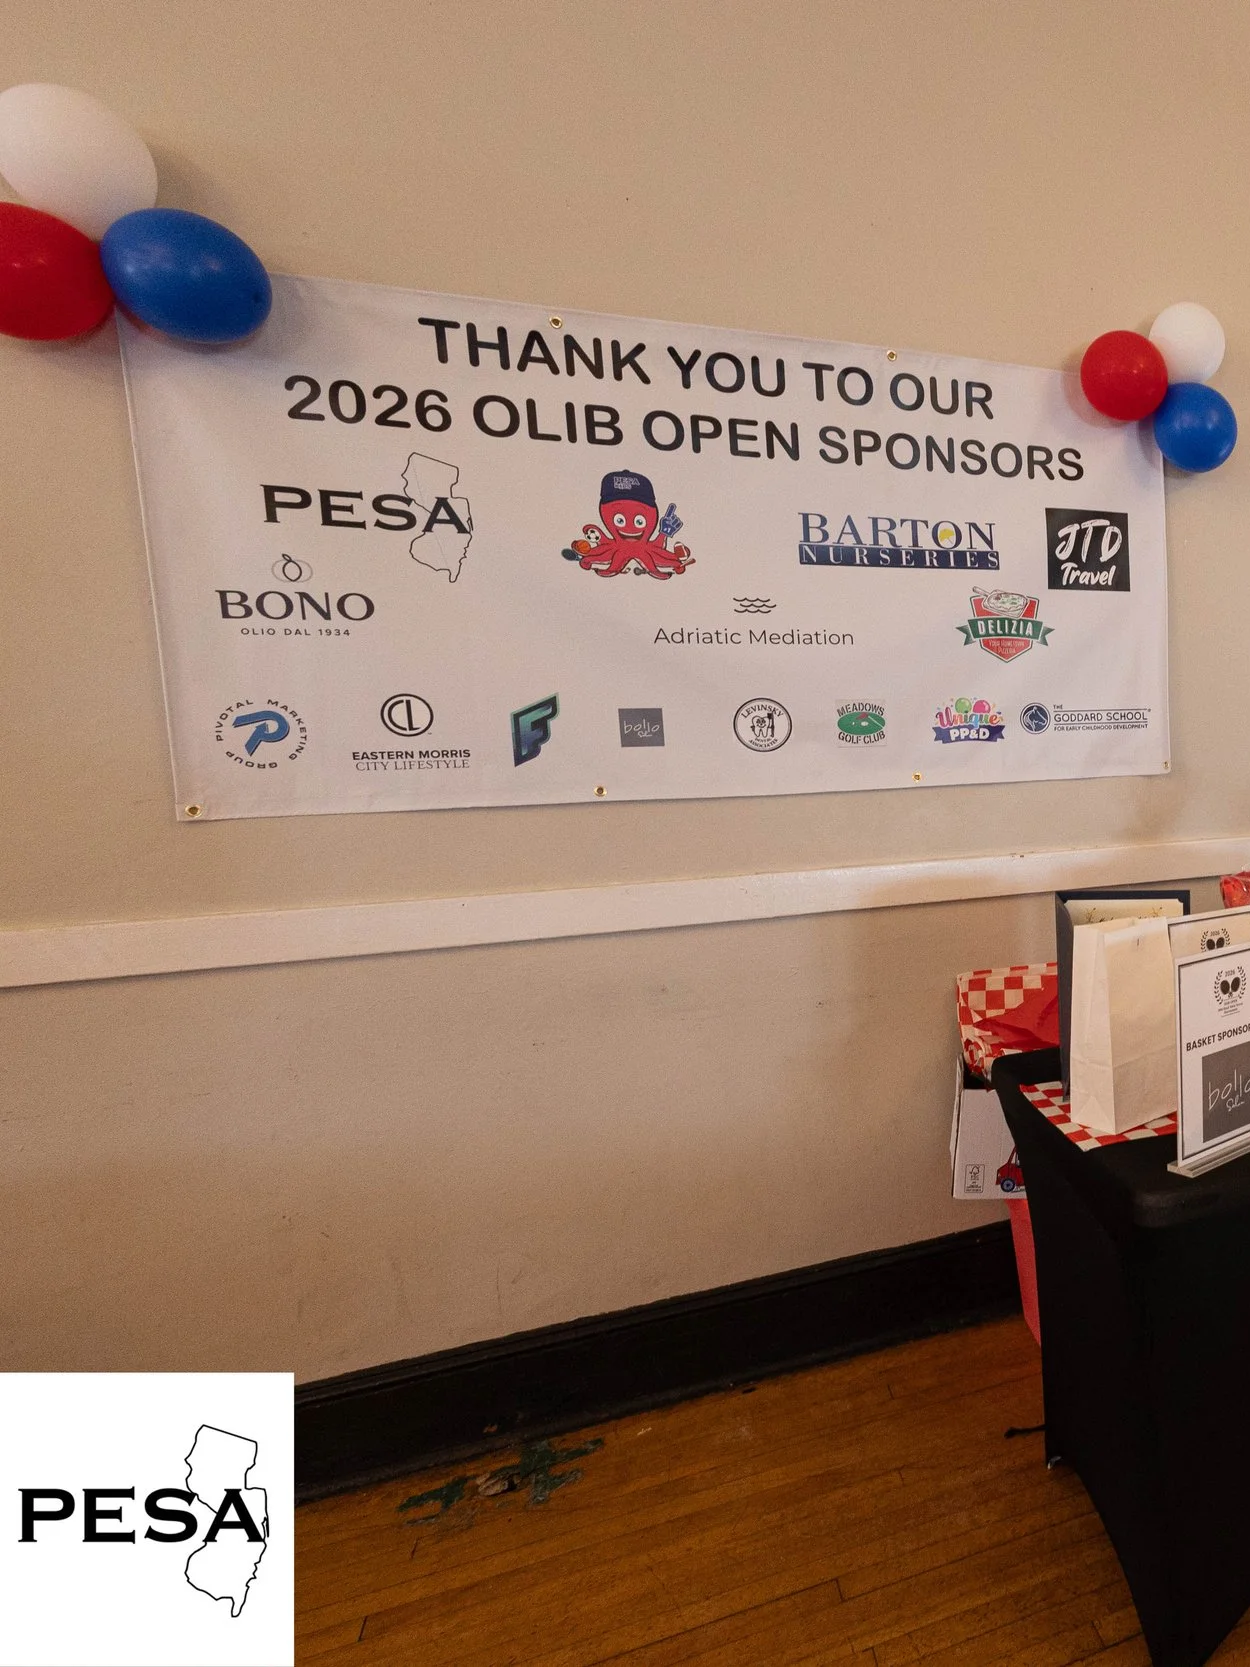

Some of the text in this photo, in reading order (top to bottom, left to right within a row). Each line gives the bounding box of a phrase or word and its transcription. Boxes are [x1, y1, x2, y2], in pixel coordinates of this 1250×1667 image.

[418, 317, 994, 420] THANK YOU TO OUR
[284, 375, 1084, 482] 2026 OLIB OPEN SPONSORS
[260, 484, 469, 534] PESA
[798, 512, 995, 550] BARTON
[1055, 518, 1123, 562] JTD
[802, 546, 999, 568] NURSERIES
[1060, 562, 1117, 586] Travel
[215, 590, 375, 621] BONO
[241, 628, 351, 637] OLIO DAL 1934
[653, 627, 854, 646] Adriatic Mediation
[977, 620, 1033, 636] DELIZIA
[741, 704, 784, 719] LEVINSKY
[837, 702, 885, 717] MEADOWS
[936, 706, 1000, 730] Unique
[1054, 711, 1147, 723] GODDARD SCHOOL
[215, 699, 253, 741] PIVOTAL
[624, 718, 660, 735] bollo
[267, 699, 307, 761] MARKETING
[838, 730, 886, 744] GOLF CLUB
[949, 727, 991, 740] PP&D
[226, 751, 278, 769] GROUP
[352, 749, 471, 760] EASTERN MORRIS
[355, 759, 470, 772] CITY LIFESTYLE
[1186, 1033, 1216, 1052] BASKET
